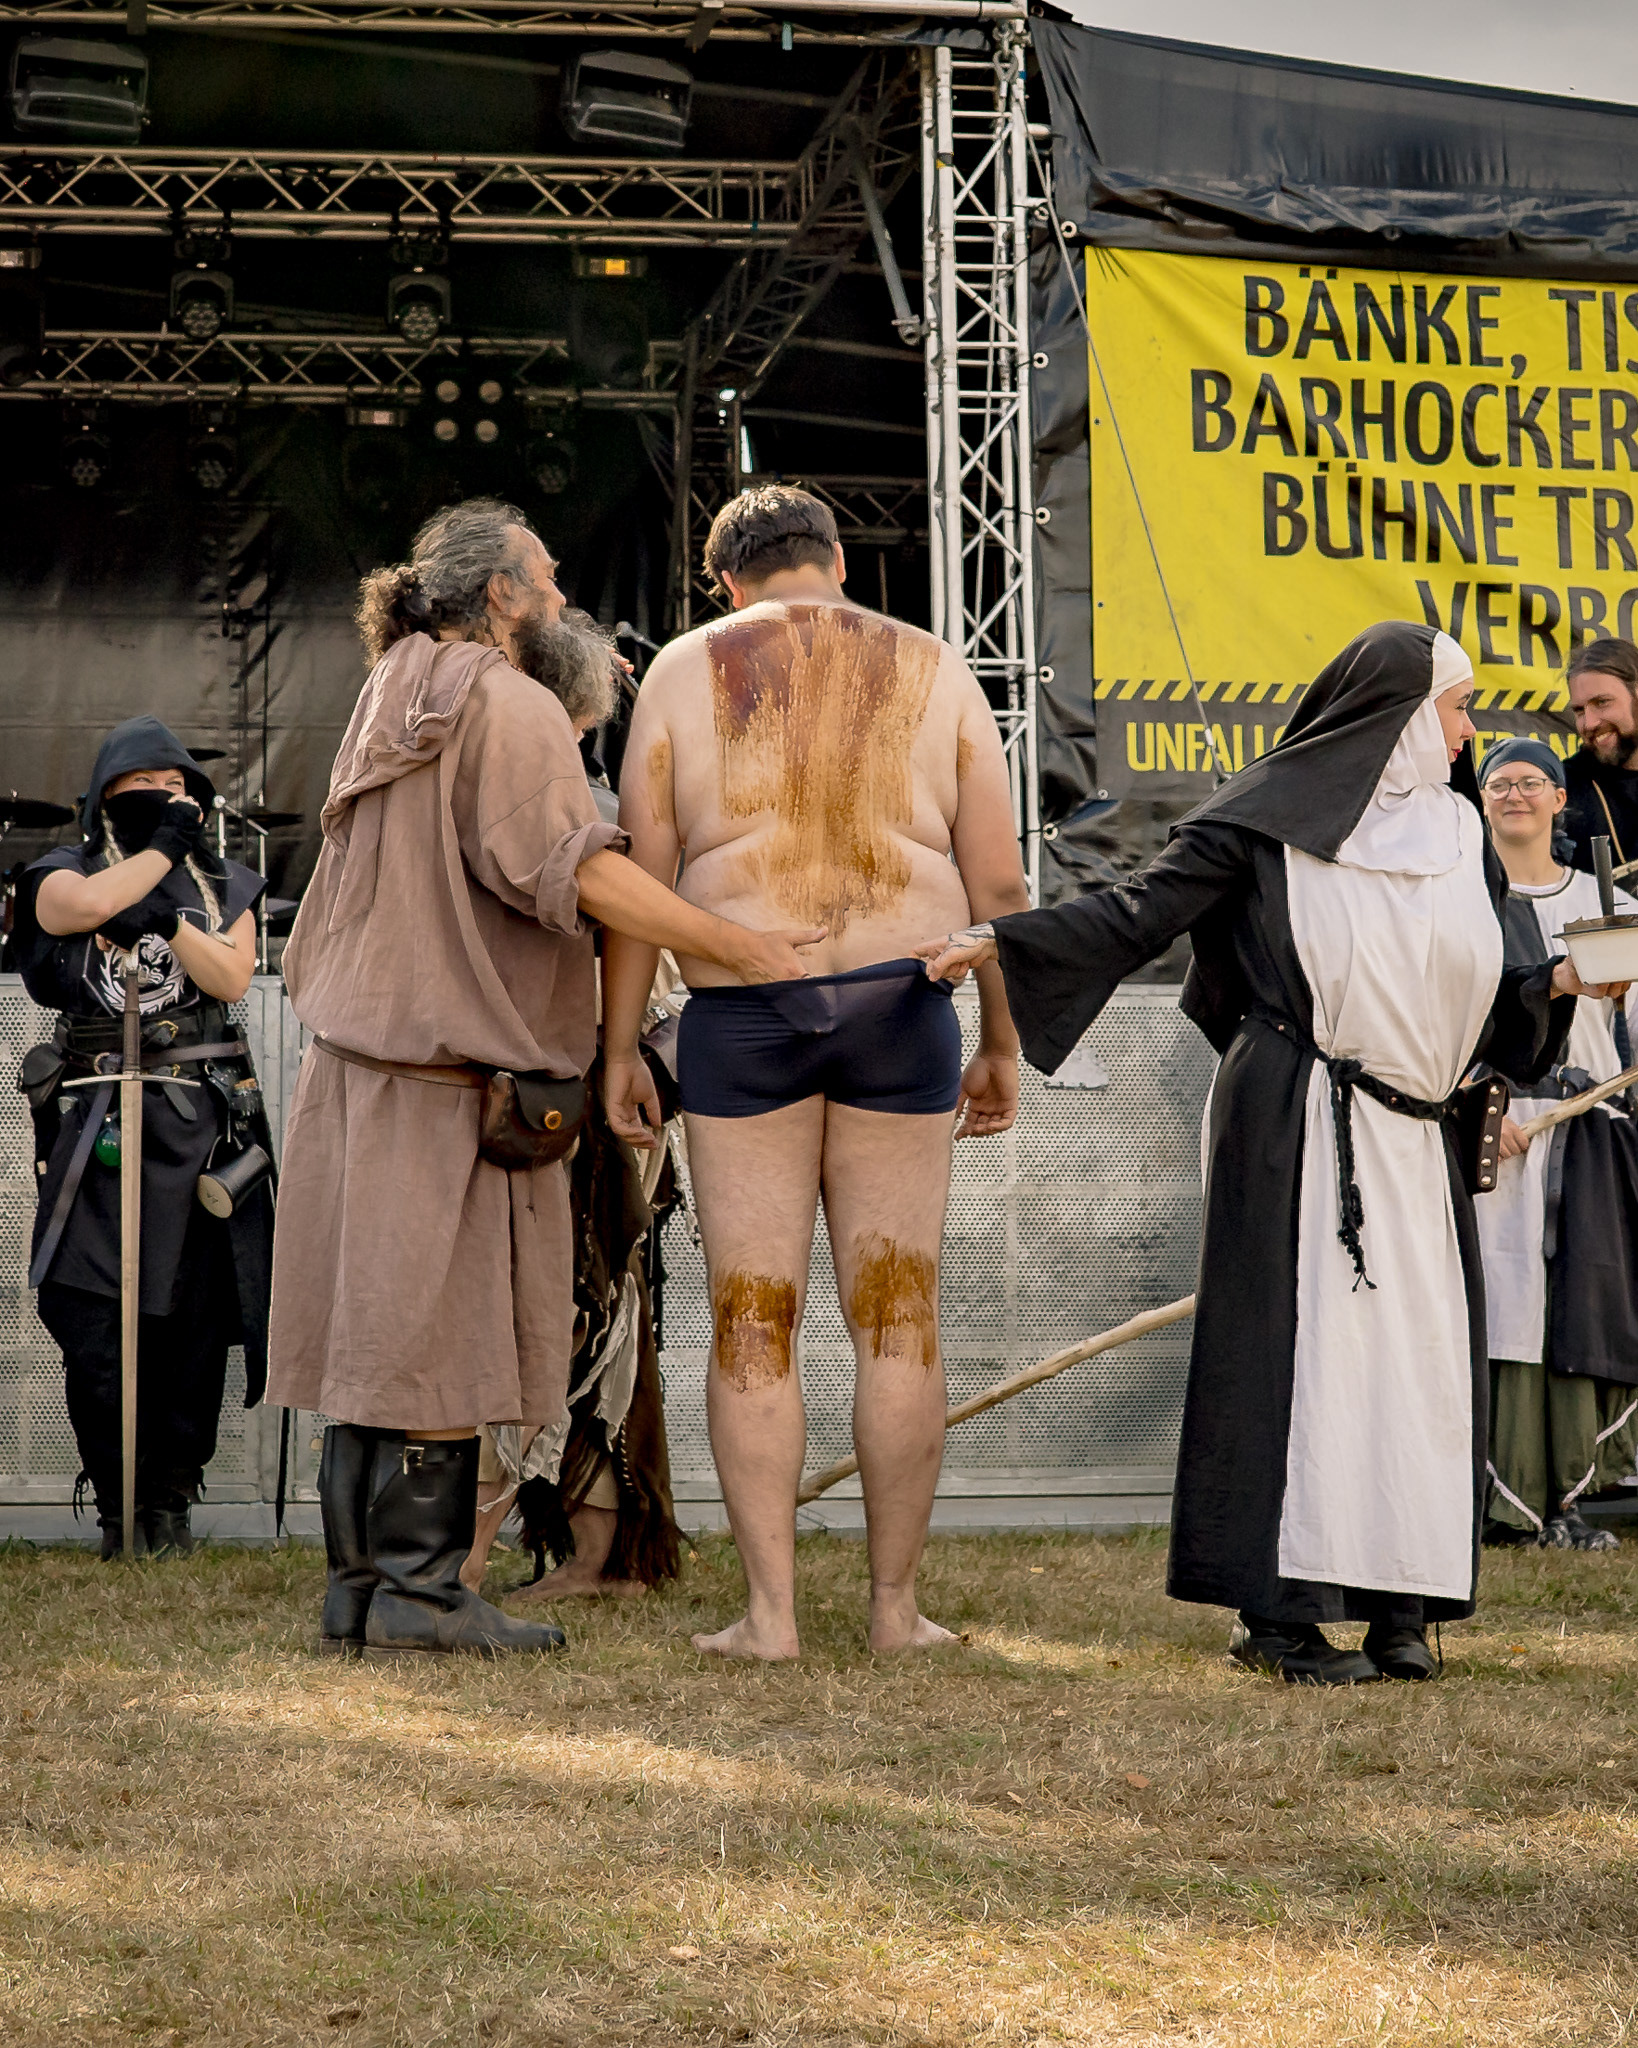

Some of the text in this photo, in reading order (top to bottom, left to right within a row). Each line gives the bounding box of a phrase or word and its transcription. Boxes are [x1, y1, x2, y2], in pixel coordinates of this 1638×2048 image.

[1244, 267, 1528, 380] BÄNKE,
[1191, 368, 1638, 472] BARHOCKER
[1263, 461, 1638, 571] BÜHNE TR
